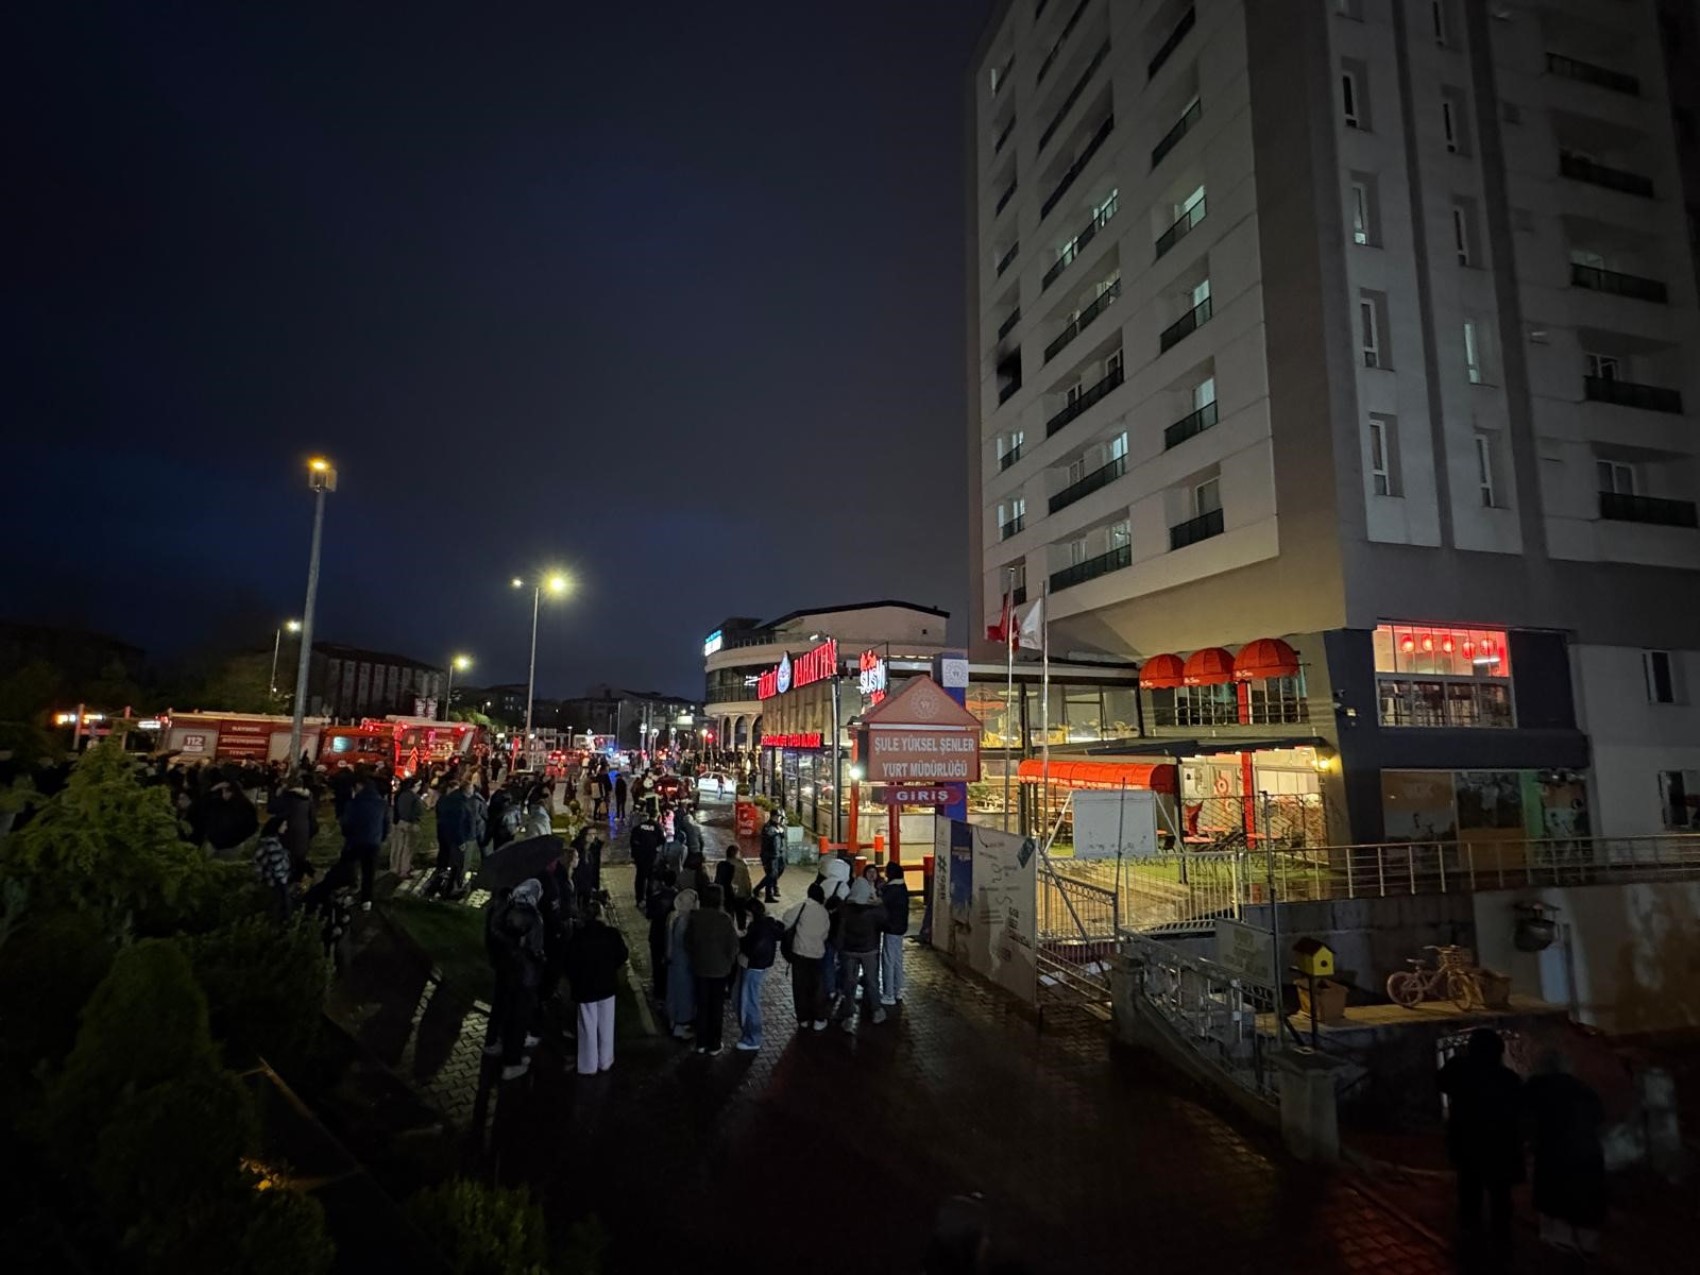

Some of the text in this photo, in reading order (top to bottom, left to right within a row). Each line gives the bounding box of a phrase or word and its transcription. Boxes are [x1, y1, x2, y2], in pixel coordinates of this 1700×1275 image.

[187, 736, 203, 746] 112
[874, 734, 975, 755] ŞULE YÜKSEL ŞENLER
[882, 759, 968, 778] YURT MÜDÜRLÜĞÜ
